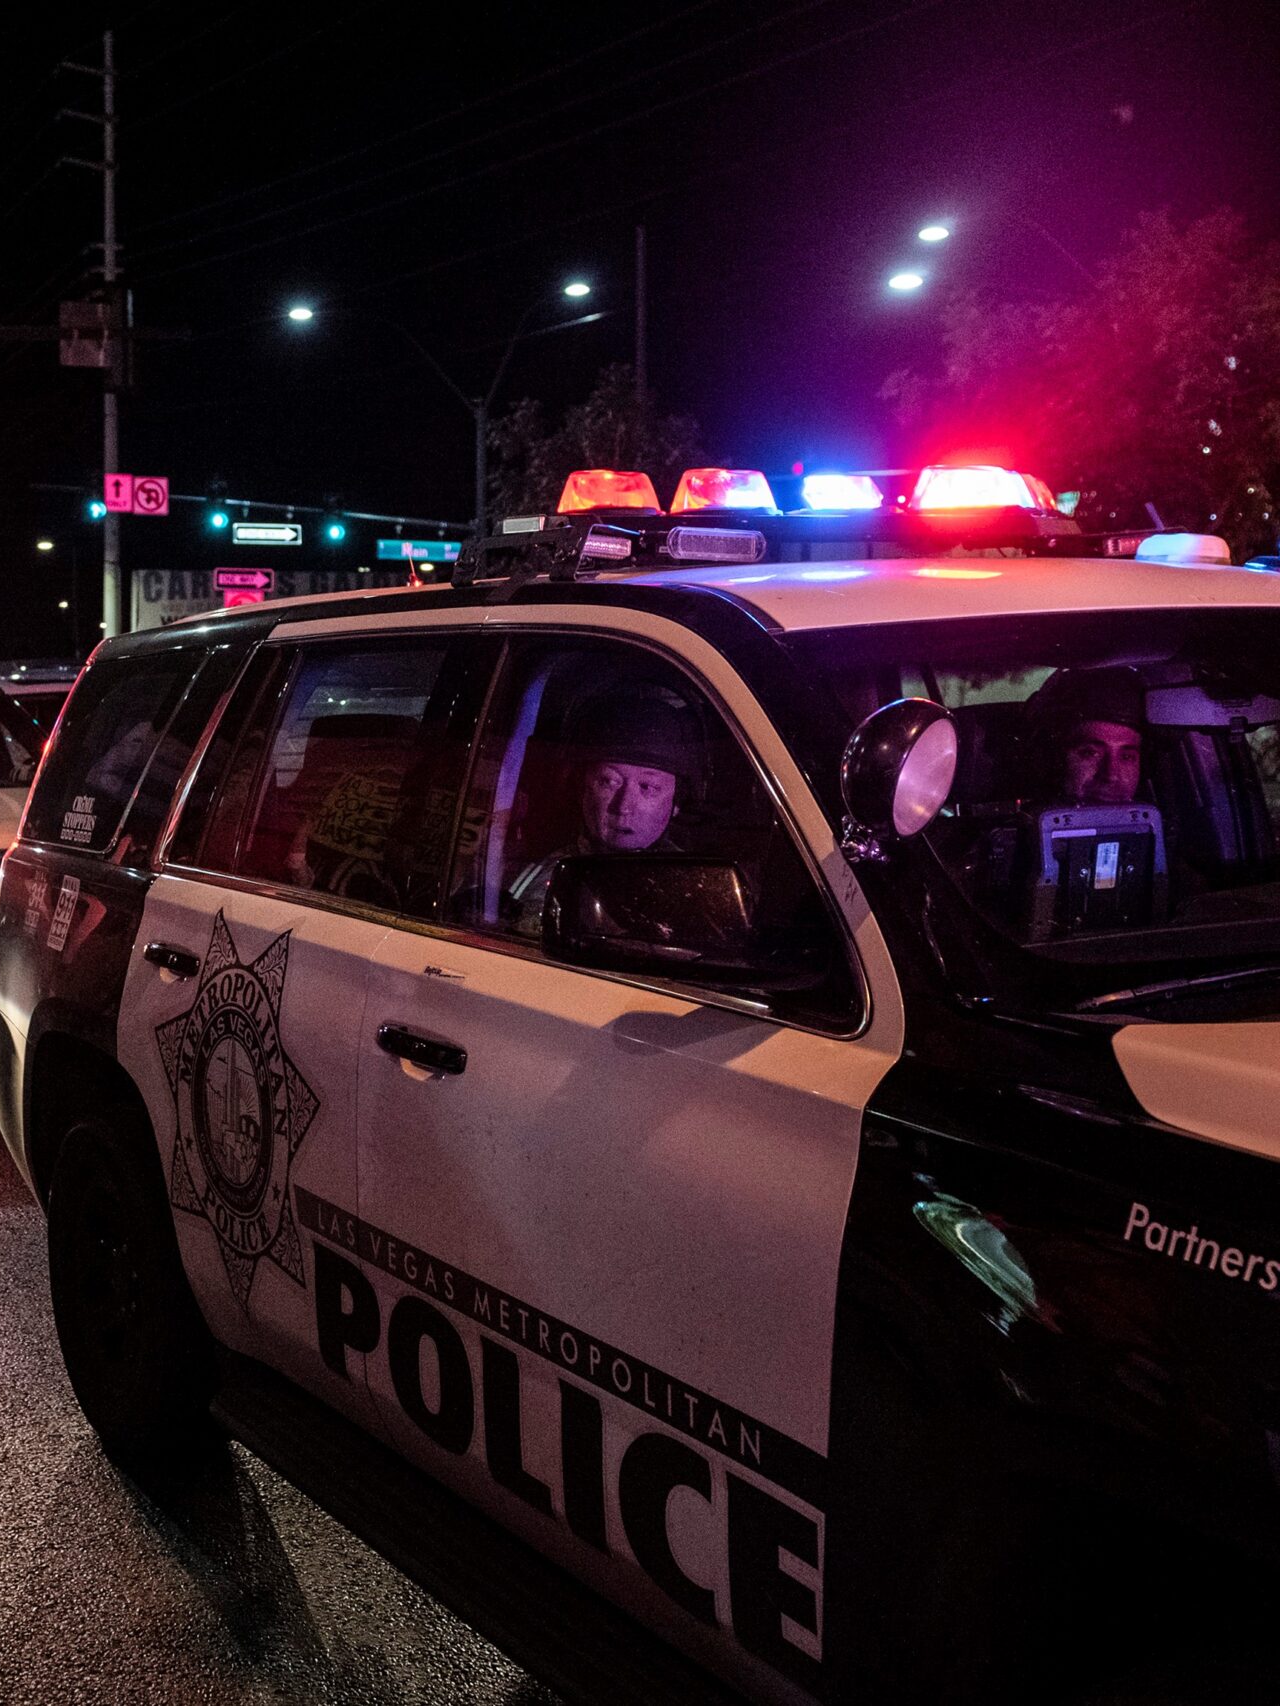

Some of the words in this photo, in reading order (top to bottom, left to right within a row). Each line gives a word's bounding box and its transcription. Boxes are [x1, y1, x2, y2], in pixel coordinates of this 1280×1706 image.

[203, 1185, 271, 1252] POLICE
[1124, 1202, 1280, 1290] Partners
[318, 1205, 356, 1247] LAS
[370, 1231, 455, 1301] VEGAS
[473, 1286, 761, 1467] METROPOLITAN
[315, 1242, 819, 1690] POLICE
